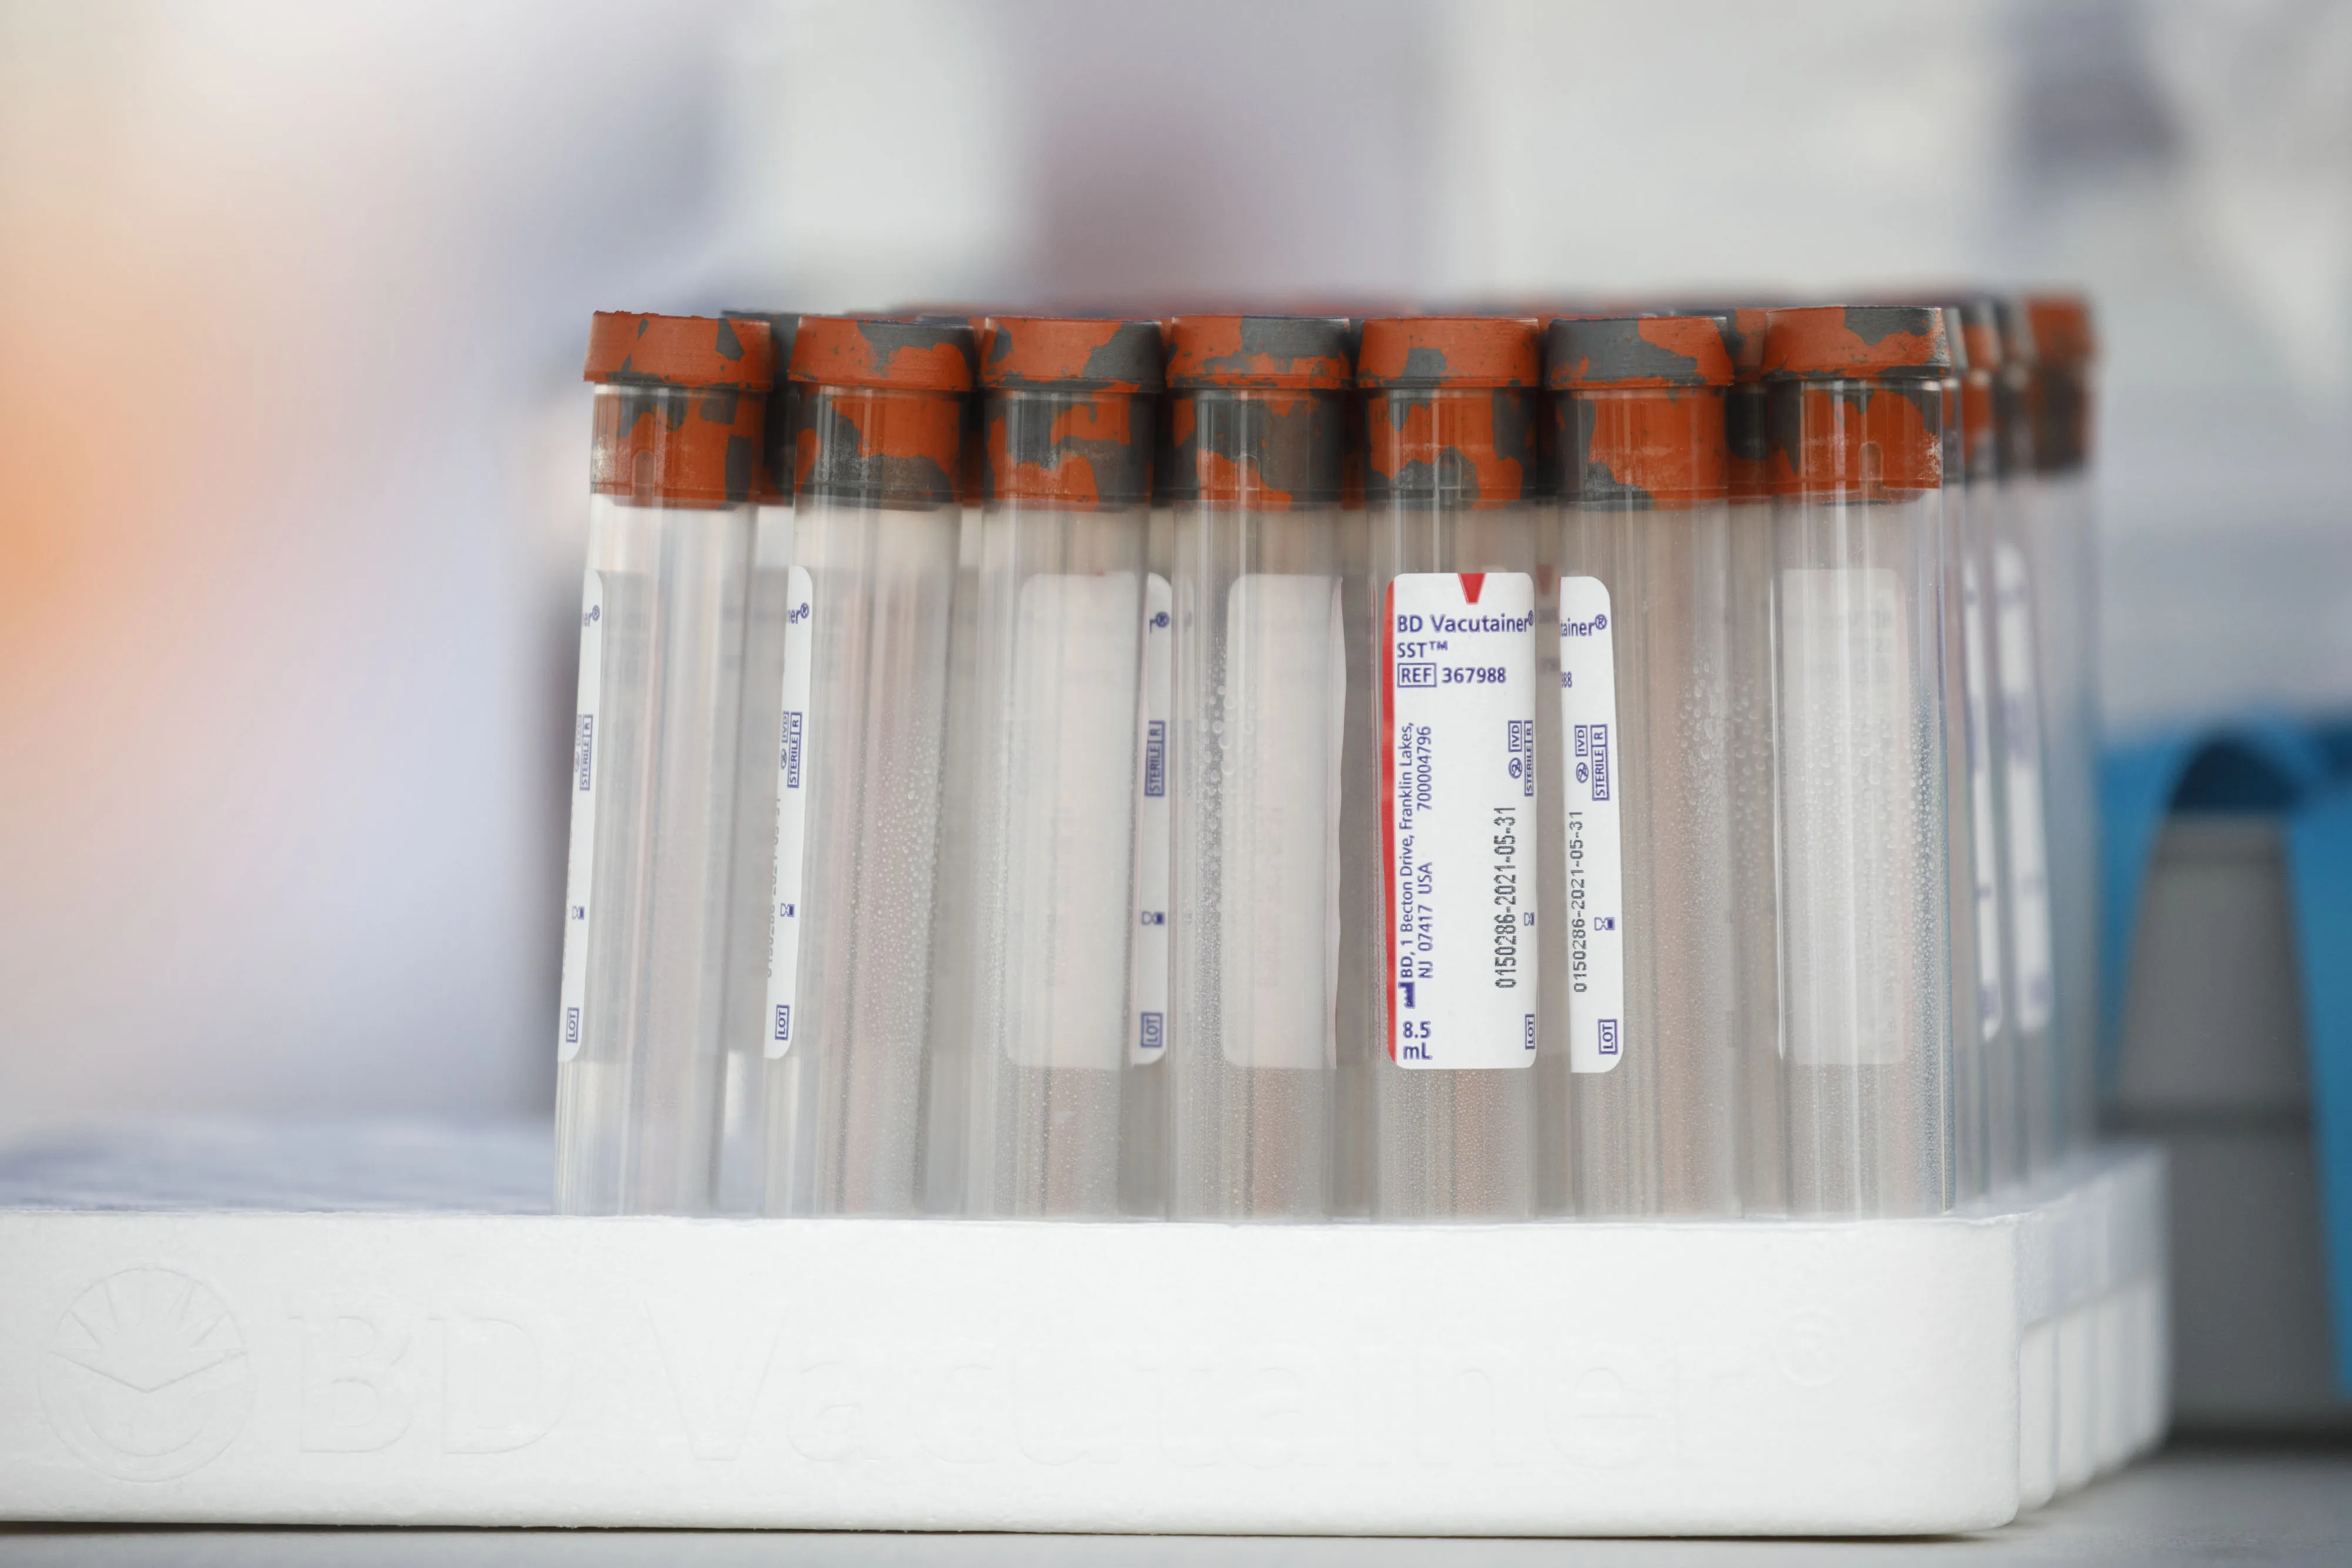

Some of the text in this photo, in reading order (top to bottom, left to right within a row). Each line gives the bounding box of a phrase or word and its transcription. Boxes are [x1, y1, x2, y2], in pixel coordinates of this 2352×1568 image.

[1397, 614, 1423, 633] BD
[1401, 667, 1506, 684] REF 367988
[1398, 722, 1415, 767] Lakes,
[1511, 725, 1521, 747] IVD
[1576, 730, 1585, 752] IVD
[789, 736, 798, 784] STERILE
[1150, 745, 1161, 793] STERILE
[1417, 726, 1432, 811] 700004796
[1594, 732, 1605, 796] STERILE R
[1398, 771, 1414, 830] Franklin
[1399, 835, 1415, 877] Drive,
[1399, 880, 1414, 932] Becton
[1494, 808, 1516, 988] 0150286-2021-05-31
[1569, 811, 1587, 992] 0150286-2021-05-31
[1418, 862, 1433, 978] NJ 07417 USA
[1399, 952, 1416, 978] BD,
[569, 1012, 577, 1038] LOT
[778, 1009, 786, 1035] LOT
[1147, 1017, 1158, 1042] LOT
[1403, 1021, 1432, 1039] 8.5
[1602, 1024, 1613, 1050] LOT
[1402, 1042, 1433, 1060] mL
[286, 1308, 573, 1457] BD
